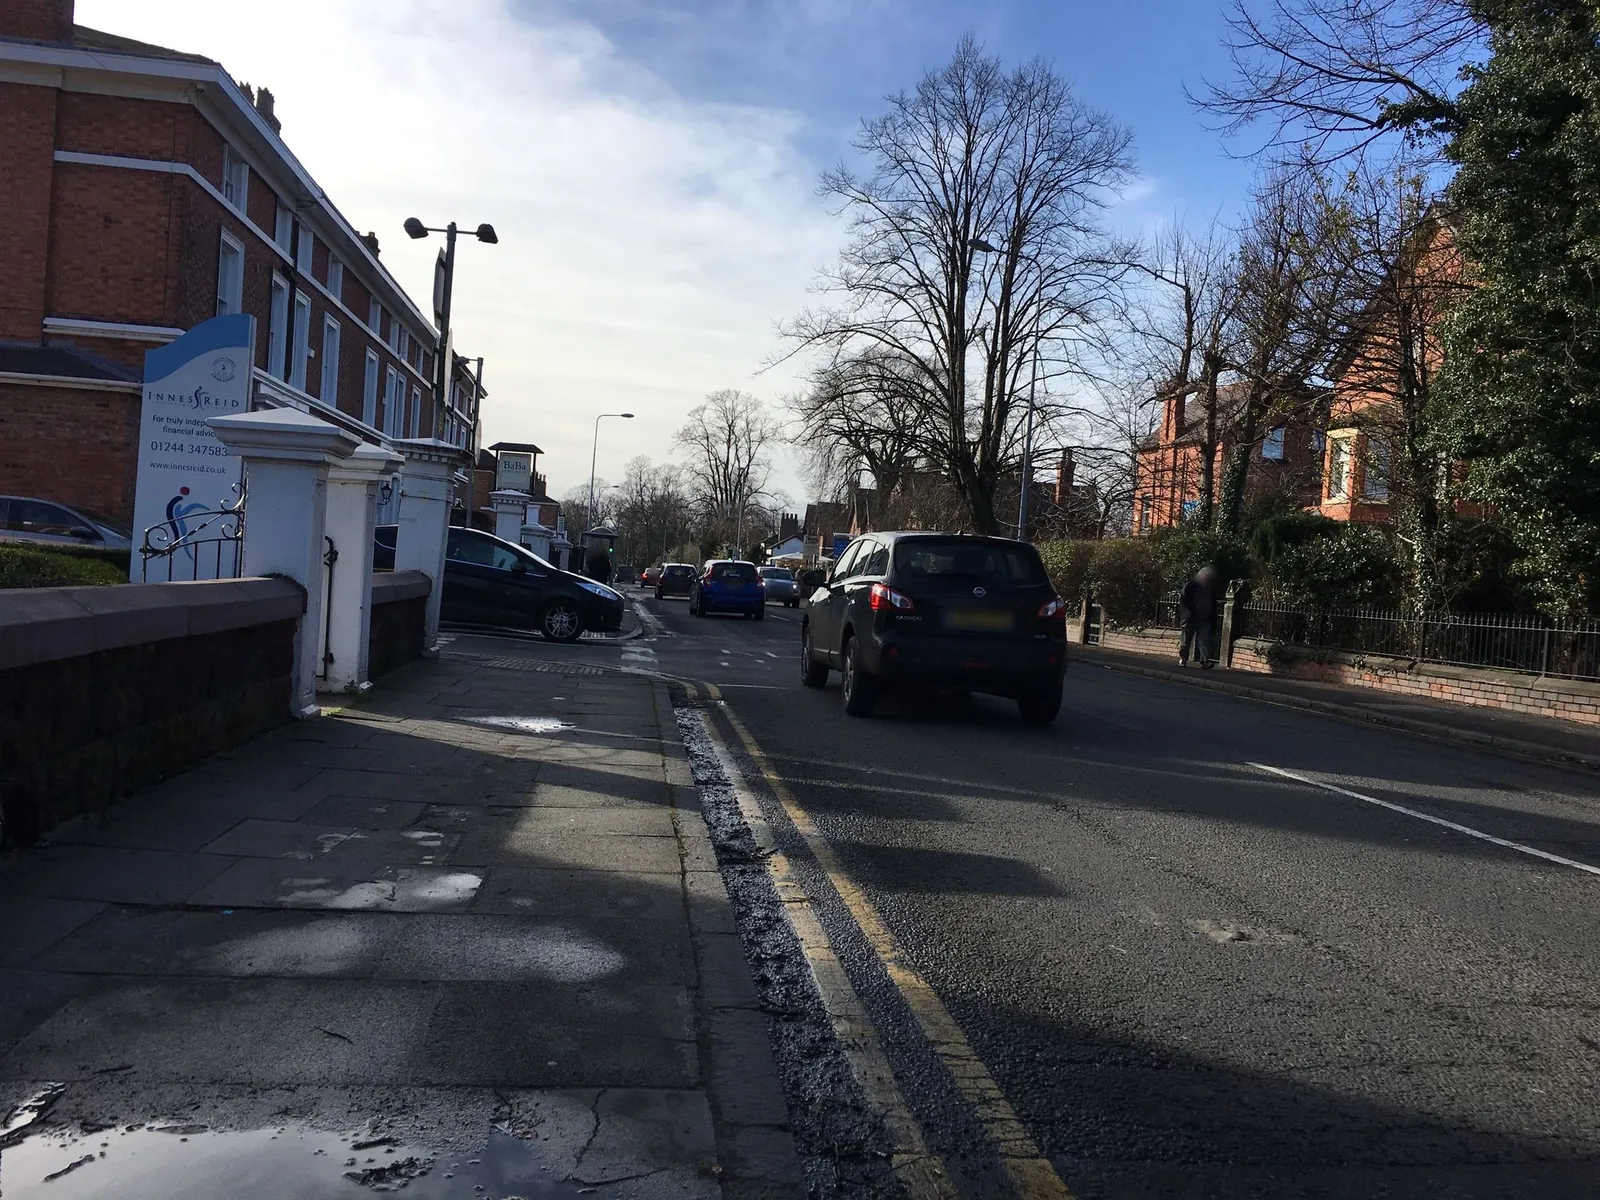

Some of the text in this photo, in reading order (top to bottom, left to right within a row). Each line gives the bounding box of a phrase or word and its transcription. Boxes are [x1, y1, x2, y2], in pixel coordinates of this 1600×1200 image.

[148, 391, 193, 404] INNES
[204, 396, 239, 408] REID
[152, 414, 207, 427] For truly indep
[162, 425, 215, 438] financial advic
[151, 440, 228, 457] 01244 347583
[149, 461, 226, 474] www.innesreid.co.uk
[504, 460, 526, 470] BaBa
